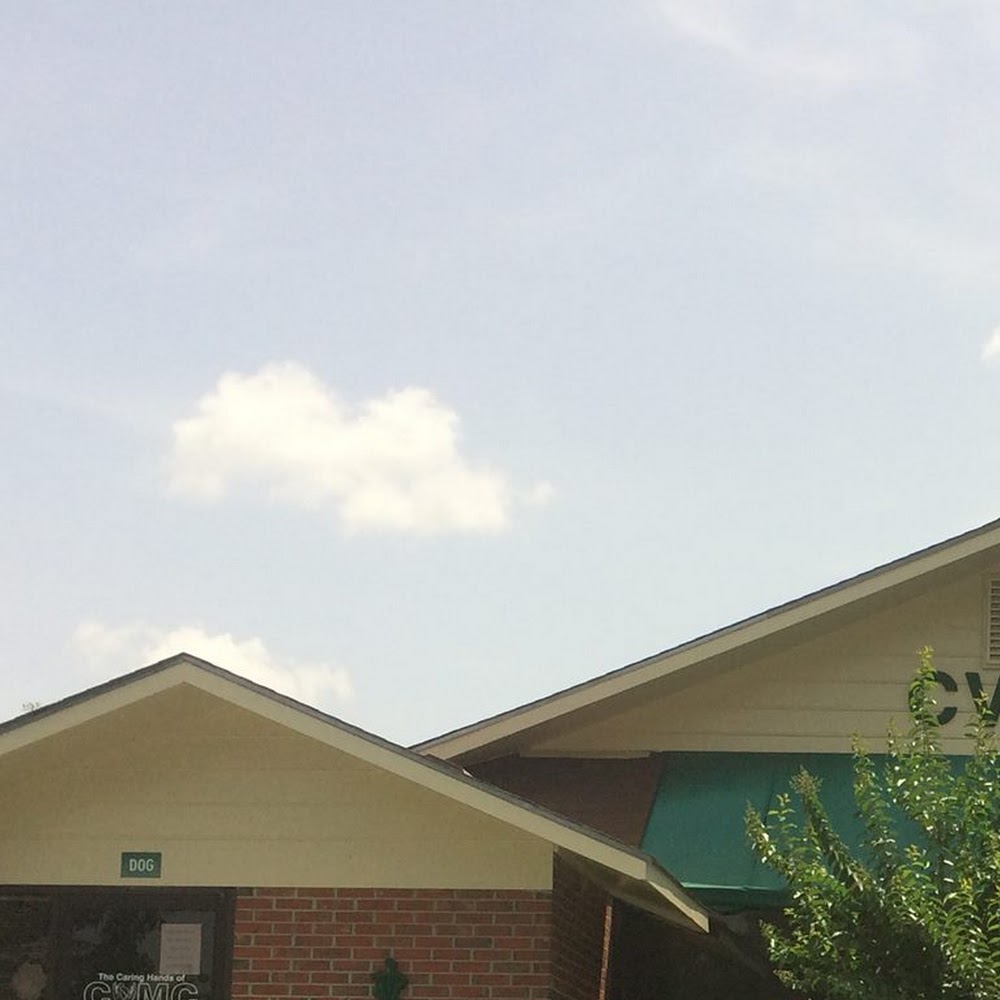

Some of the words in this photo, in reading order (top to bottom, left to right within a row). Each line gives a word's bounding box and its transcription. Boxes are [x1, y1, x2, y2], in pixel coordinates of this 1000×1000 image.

[129, 858, 154, 872] DOG
[98, 972, 114, 981] The
[116, 973, 145, 983] Caring
[147, 973, 174, 982] Hands
[176, 974, 186, 982] of
